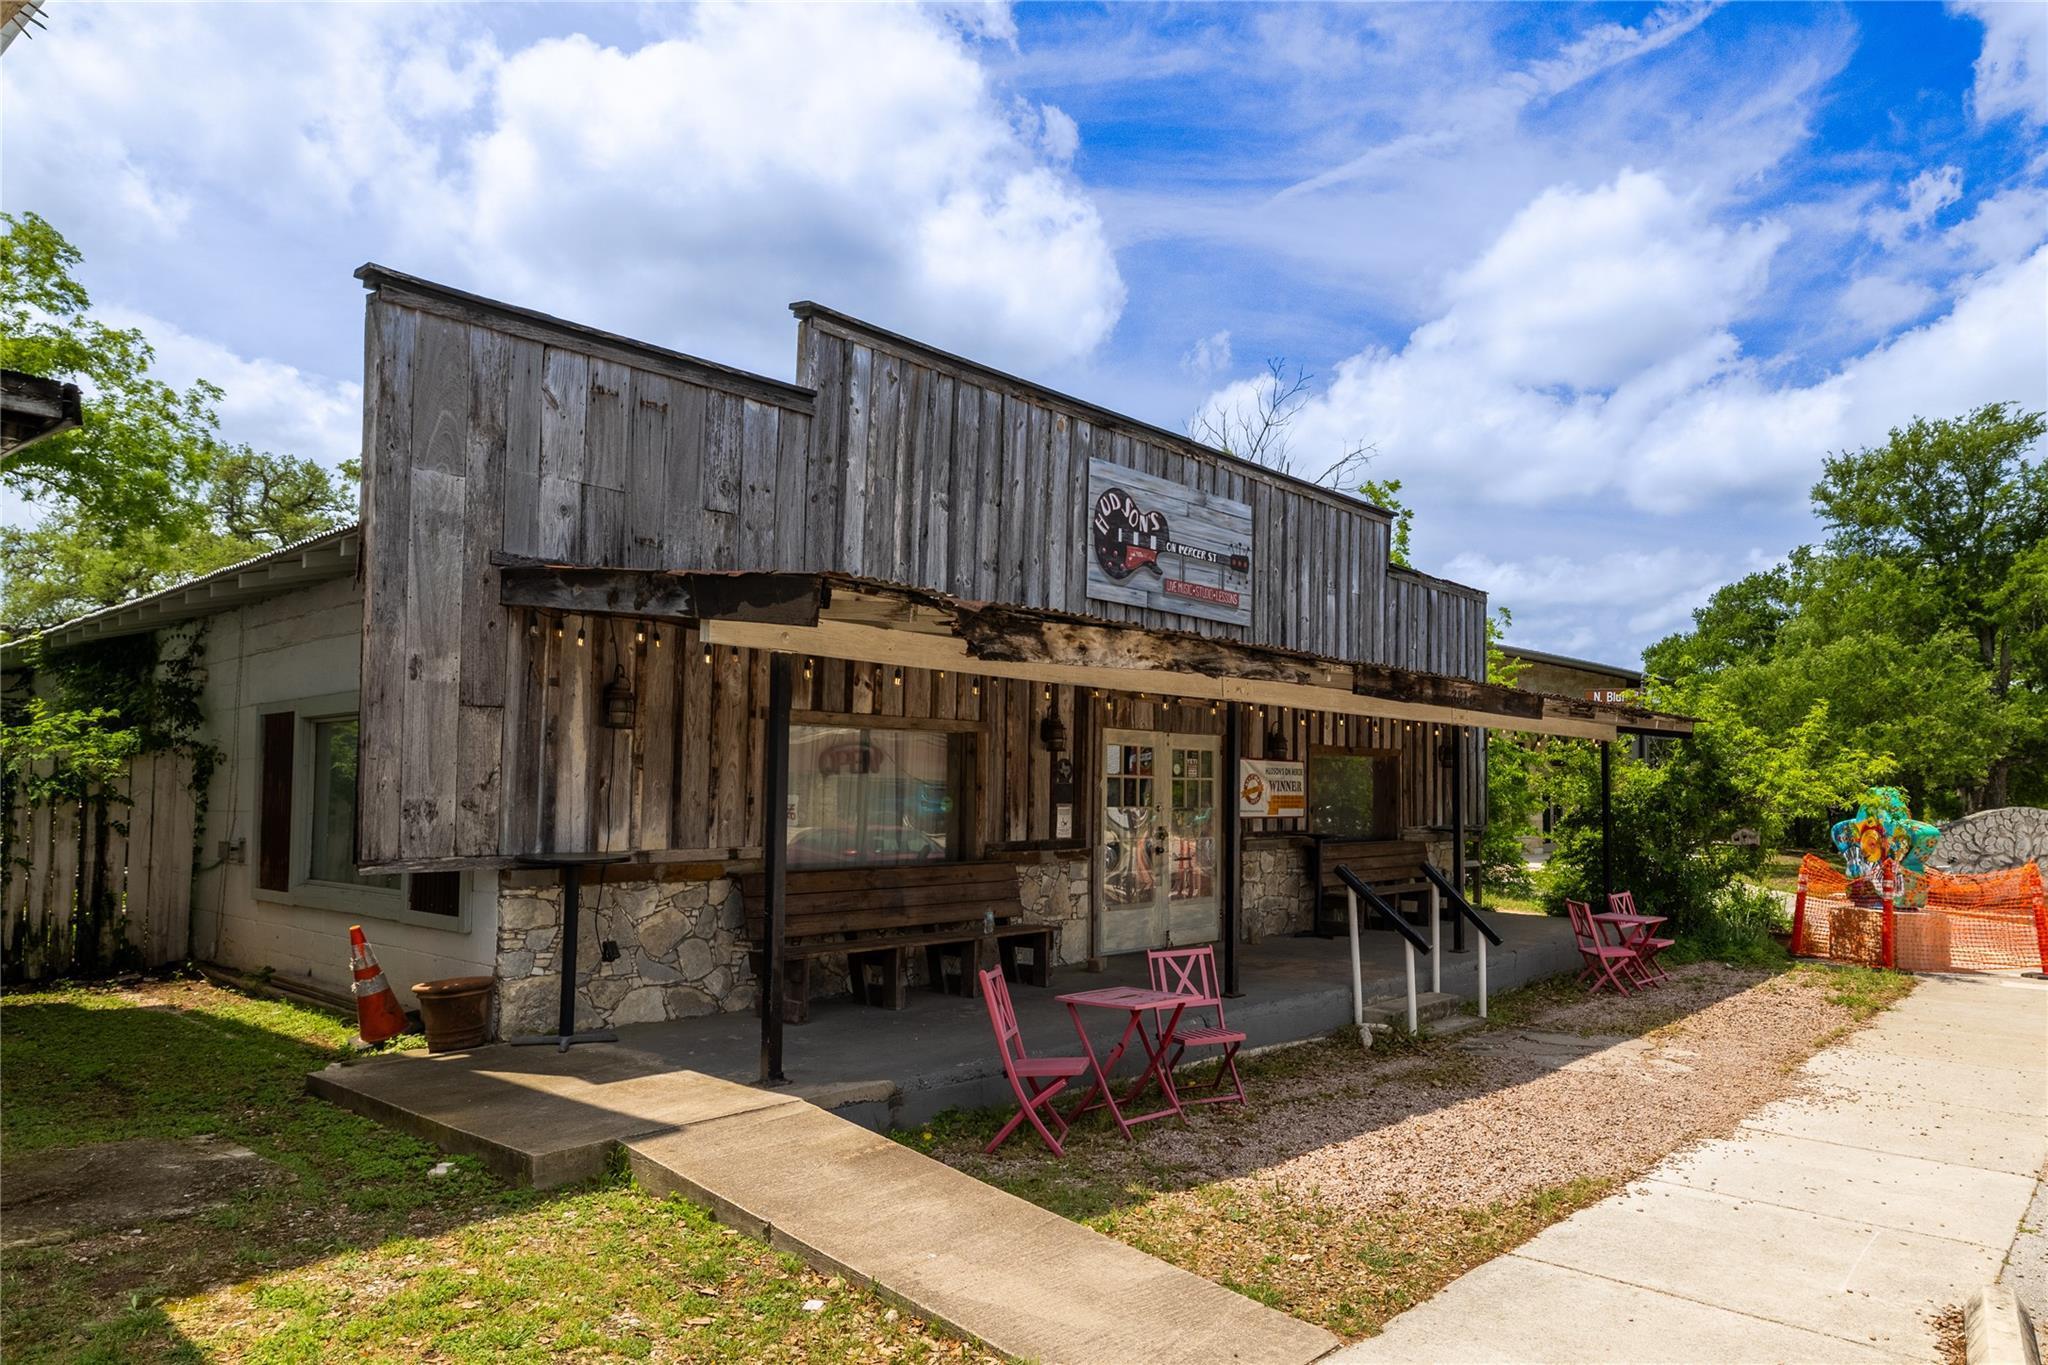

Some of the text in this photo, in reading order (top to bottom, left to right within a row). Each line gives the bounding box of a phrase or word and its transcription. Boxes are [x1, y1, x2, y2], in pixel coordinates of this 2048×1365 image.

[1095, 492, 1161, 536] HUDSON'S
[1166, 541, 1217, 563] ON MERCER ST
[1166, 580, 1177, 593] LIVE
[1177, 582, 1193, 596] MUSIC
[1215, 590, 1238, 605] LESSONS
[1593, 691, 1602, 703] N.
[1269, 780, 1302, 792] WINNER
